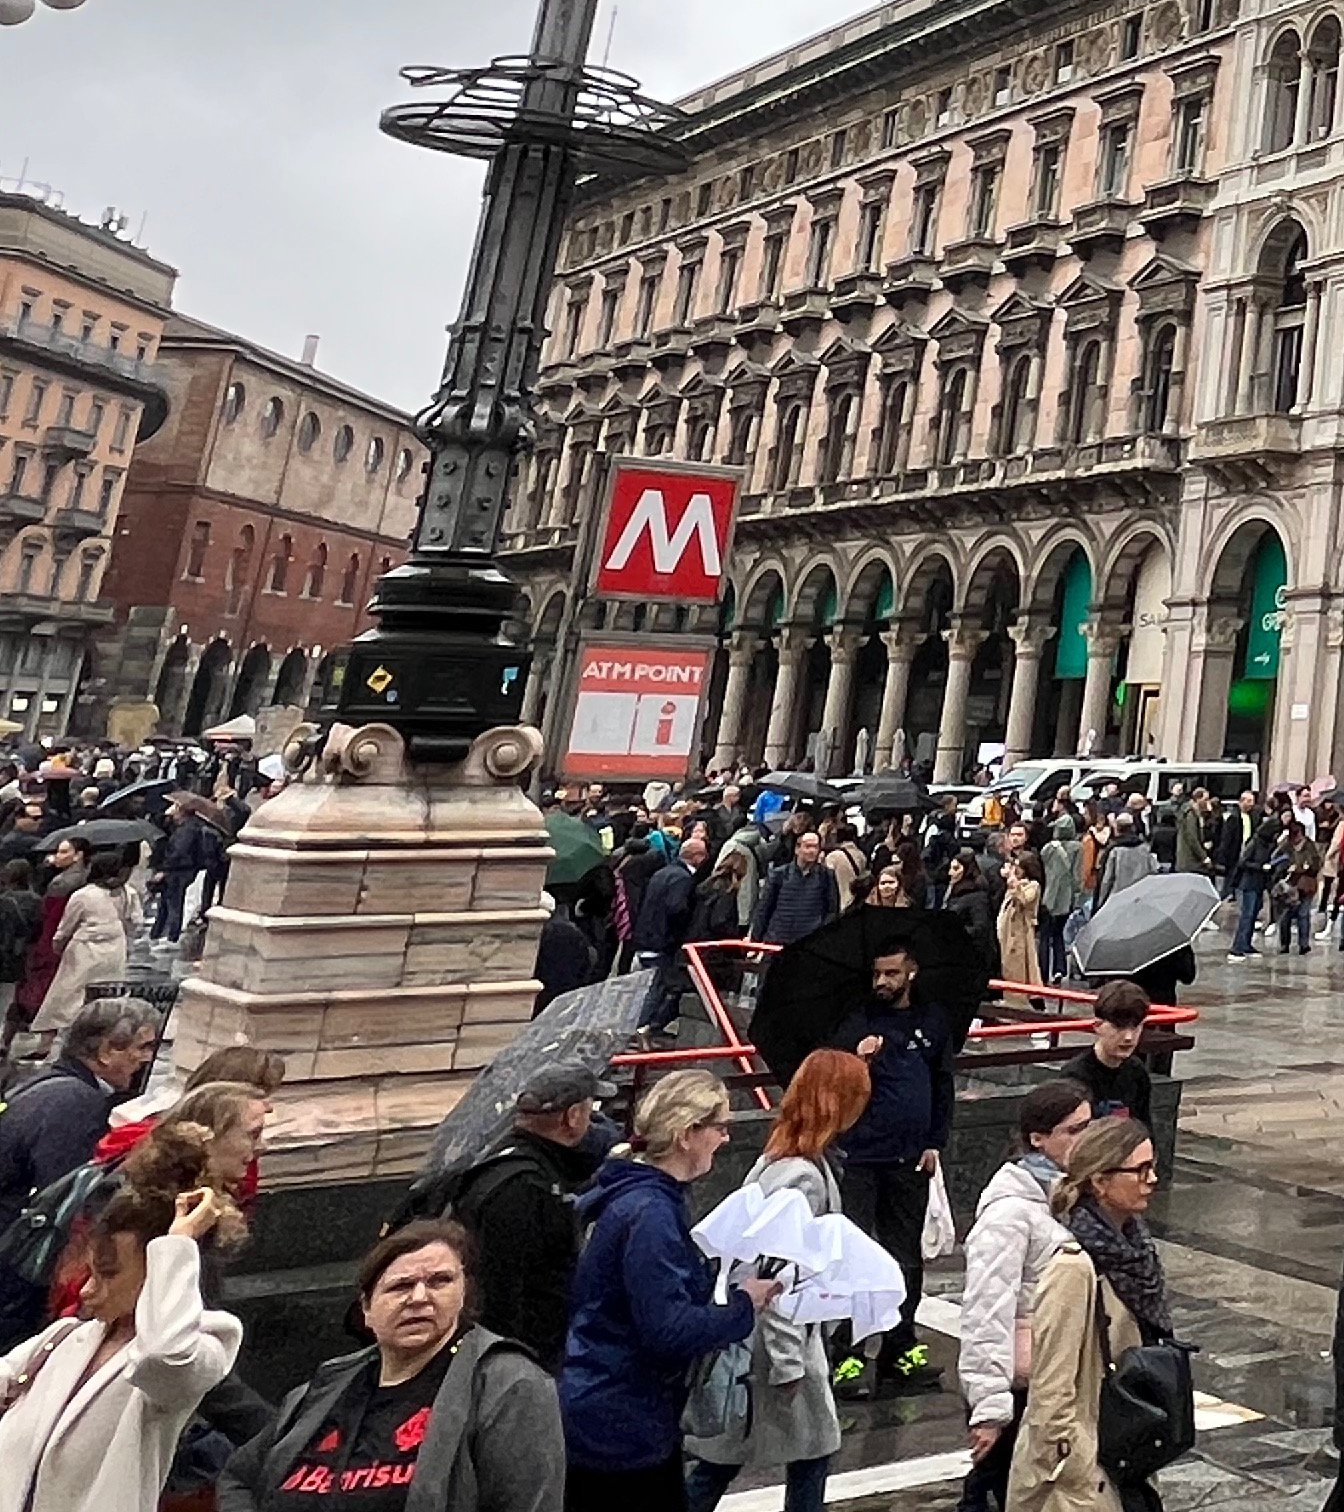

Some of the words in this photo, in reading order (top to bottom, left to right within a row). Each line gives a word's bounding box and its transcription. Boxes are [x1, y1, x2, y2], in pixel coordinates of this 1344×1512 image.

[604, 488, 722, 576] M
[582, 661, 631, 680] ATM
[634, 664, 704, 684] POINT
